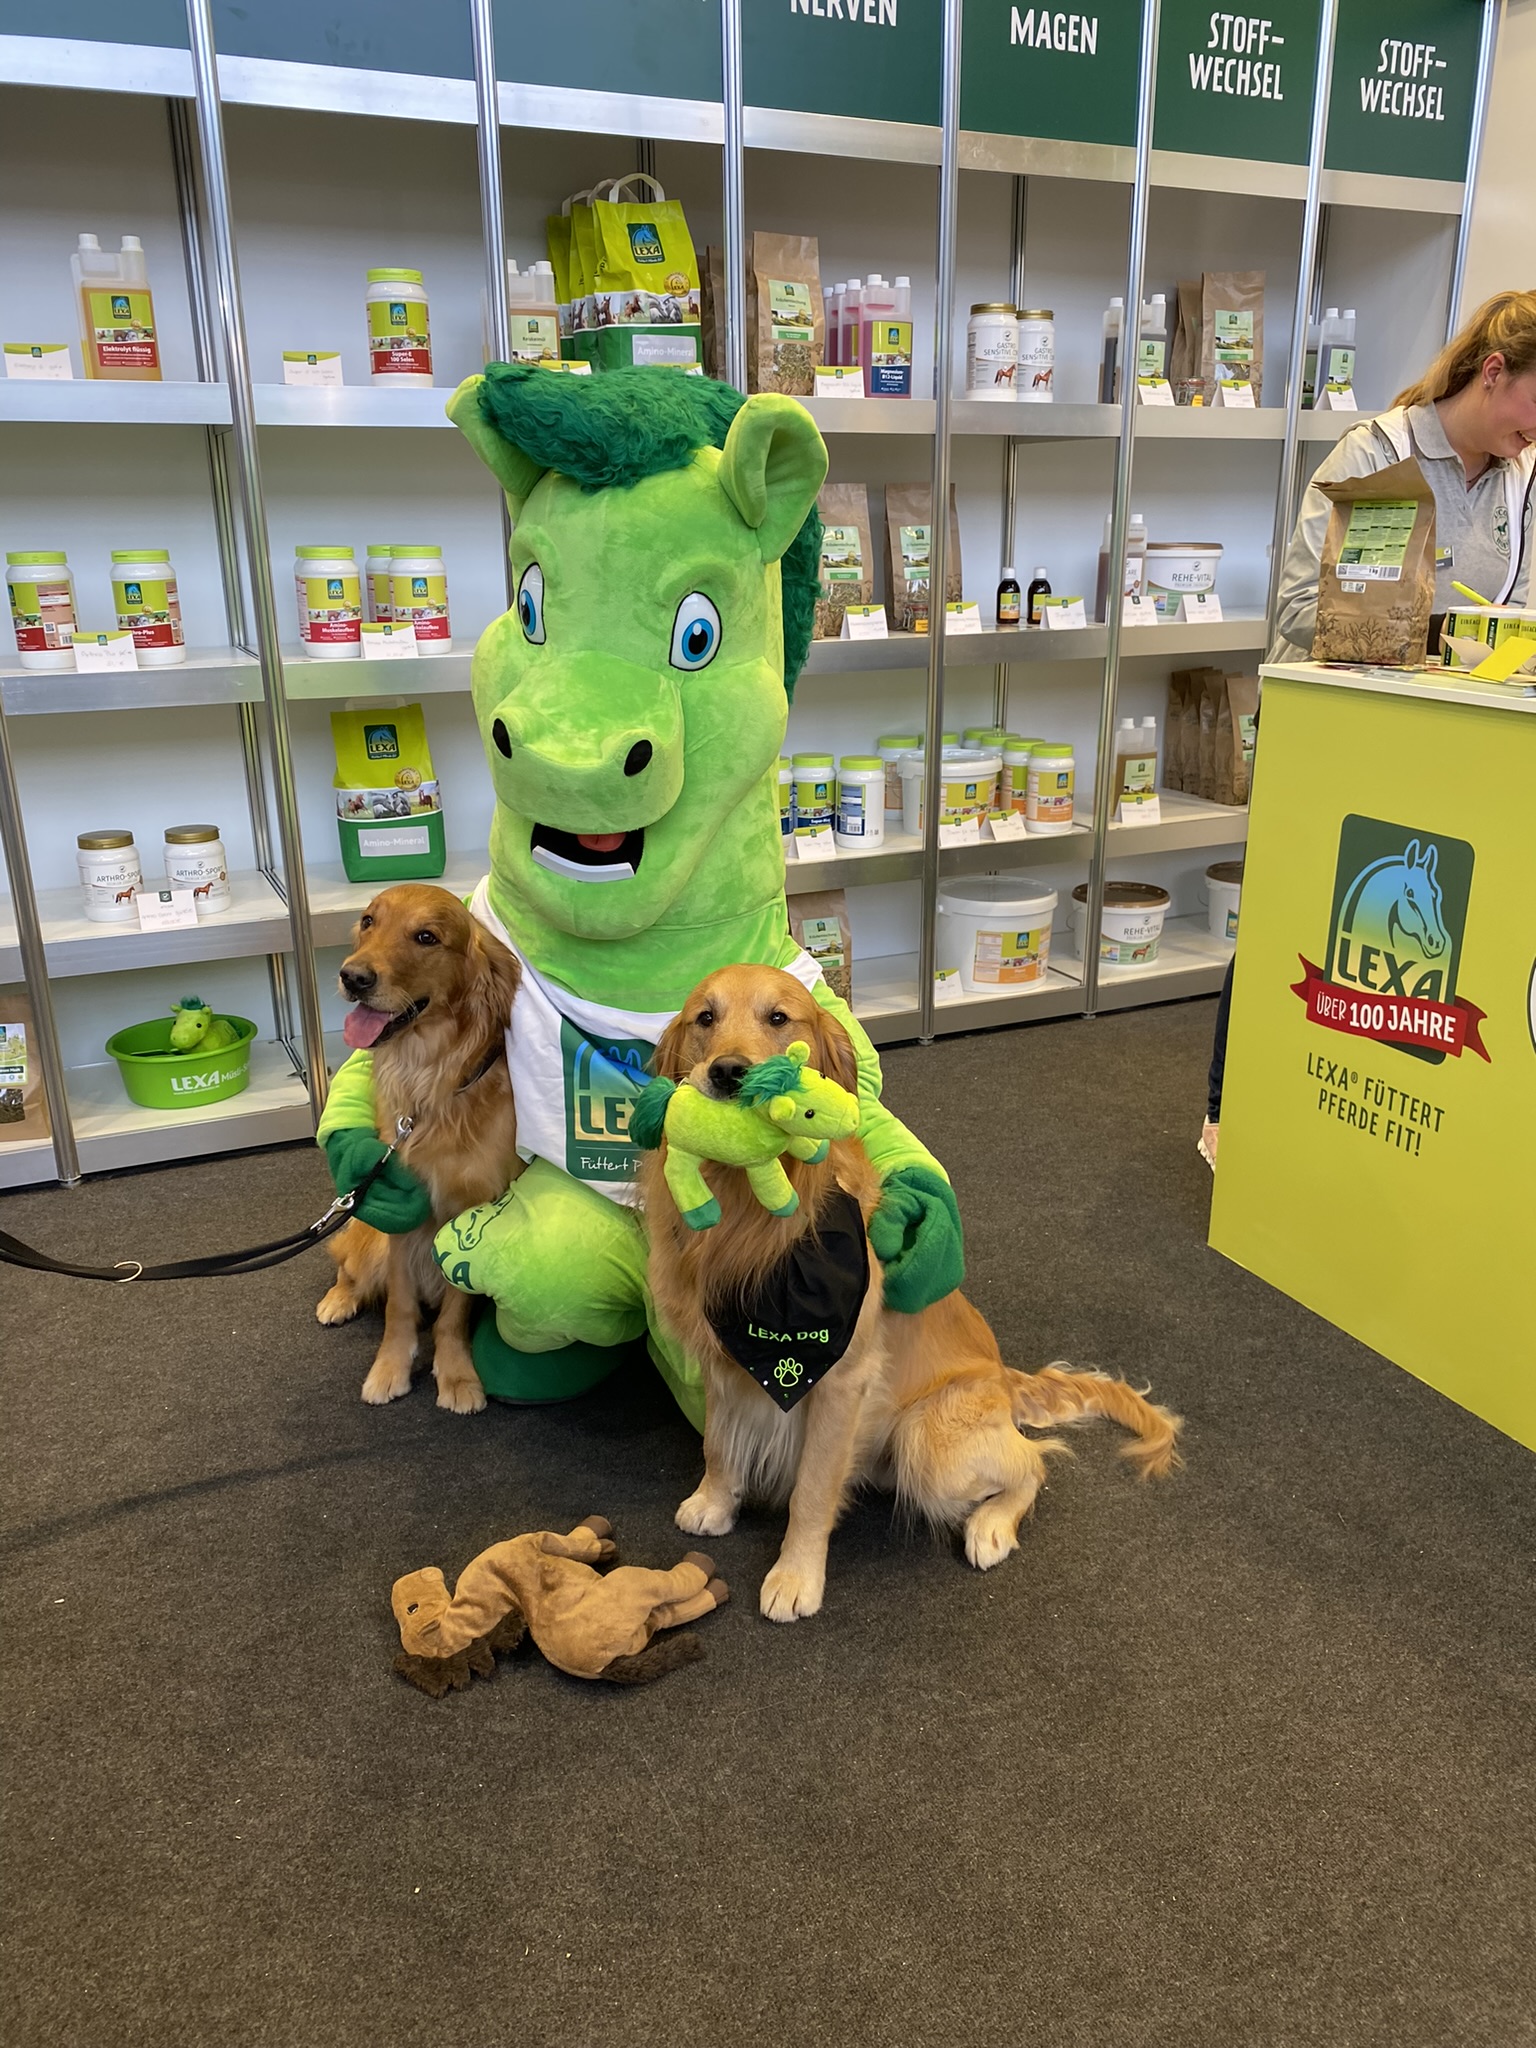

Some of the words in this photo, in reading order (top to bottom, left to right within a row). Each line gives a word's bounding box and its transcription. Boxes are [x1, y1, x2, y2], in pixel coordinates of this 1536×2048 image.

[1010, 6, 1098, 55] MAGEN
[1207, 11, 1285, 56] STOFF-
[1189, 53, 1284, 100] WECHSEL
[1377, 38, 1447, 78] STOFF-
[1360, 77, 1445, 121] WECHSEL
[634, 245, 660, 256] LEXA
[102, 345, 132, 354] Elektrolyt
[637, 346, 694, 357] Amino-Mineral
[369, 743, 396, 753] LEXA
[363, 836, 425, 848] Amino-Mineral
[96, 870, 140, 882] ARTHRO-SPO
[1337, 936, 1444, 1003] LEXA
[1316, 991, 1346, 1021] ÜBER
[1349, 1002, 1384, 1031] 100
[1387, 1005, 1456, 1043] JAHRE
[171, 1070, 220, 1092] LEXA
[221, 1064, 249, 1082] Müsli-S
[579, 1095, 640, 1136] LE
[1318, 1088, 1379, 1136] PFERDE
[1385, 1119, 1422, 1157] FIT!
[1363, 1077, 1445, 1133] FÜTTERT
[580, 1156, 629, 1171] Füttert
[748, 1323, 792, 1343] LEXA
[796, 1328, 829, 1344] Dog
